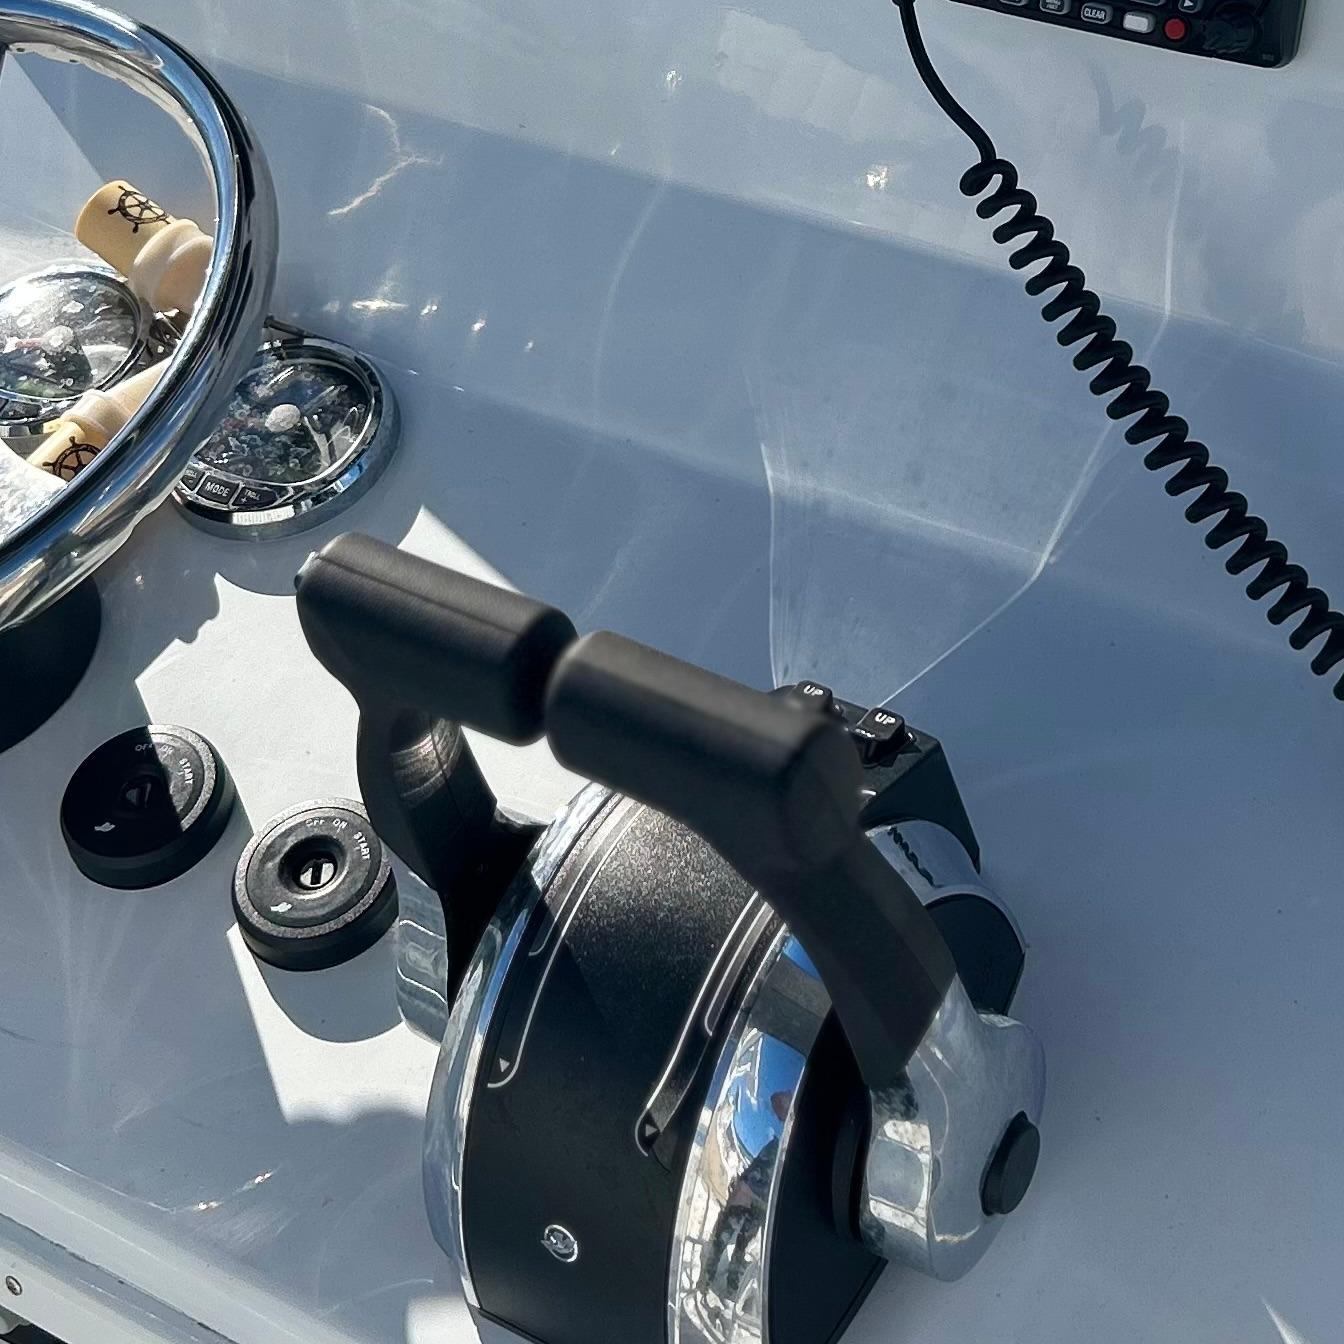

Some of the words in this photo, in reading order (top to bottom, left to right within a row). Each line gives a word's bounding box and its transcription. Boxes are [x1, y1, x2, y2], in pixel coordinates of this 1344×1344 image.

[1083, 6, 1106, 21] CLEAR
[204, 480, 231, 498] MODE
[803, 684, 824, 697] UP
[874, 712, 896, 725] UP
[178, 757, 194, 785] START
[304, 818, 326, 828] OFF
[332, 817, 348, 829] ON
[353, 831, 371, 860] START
